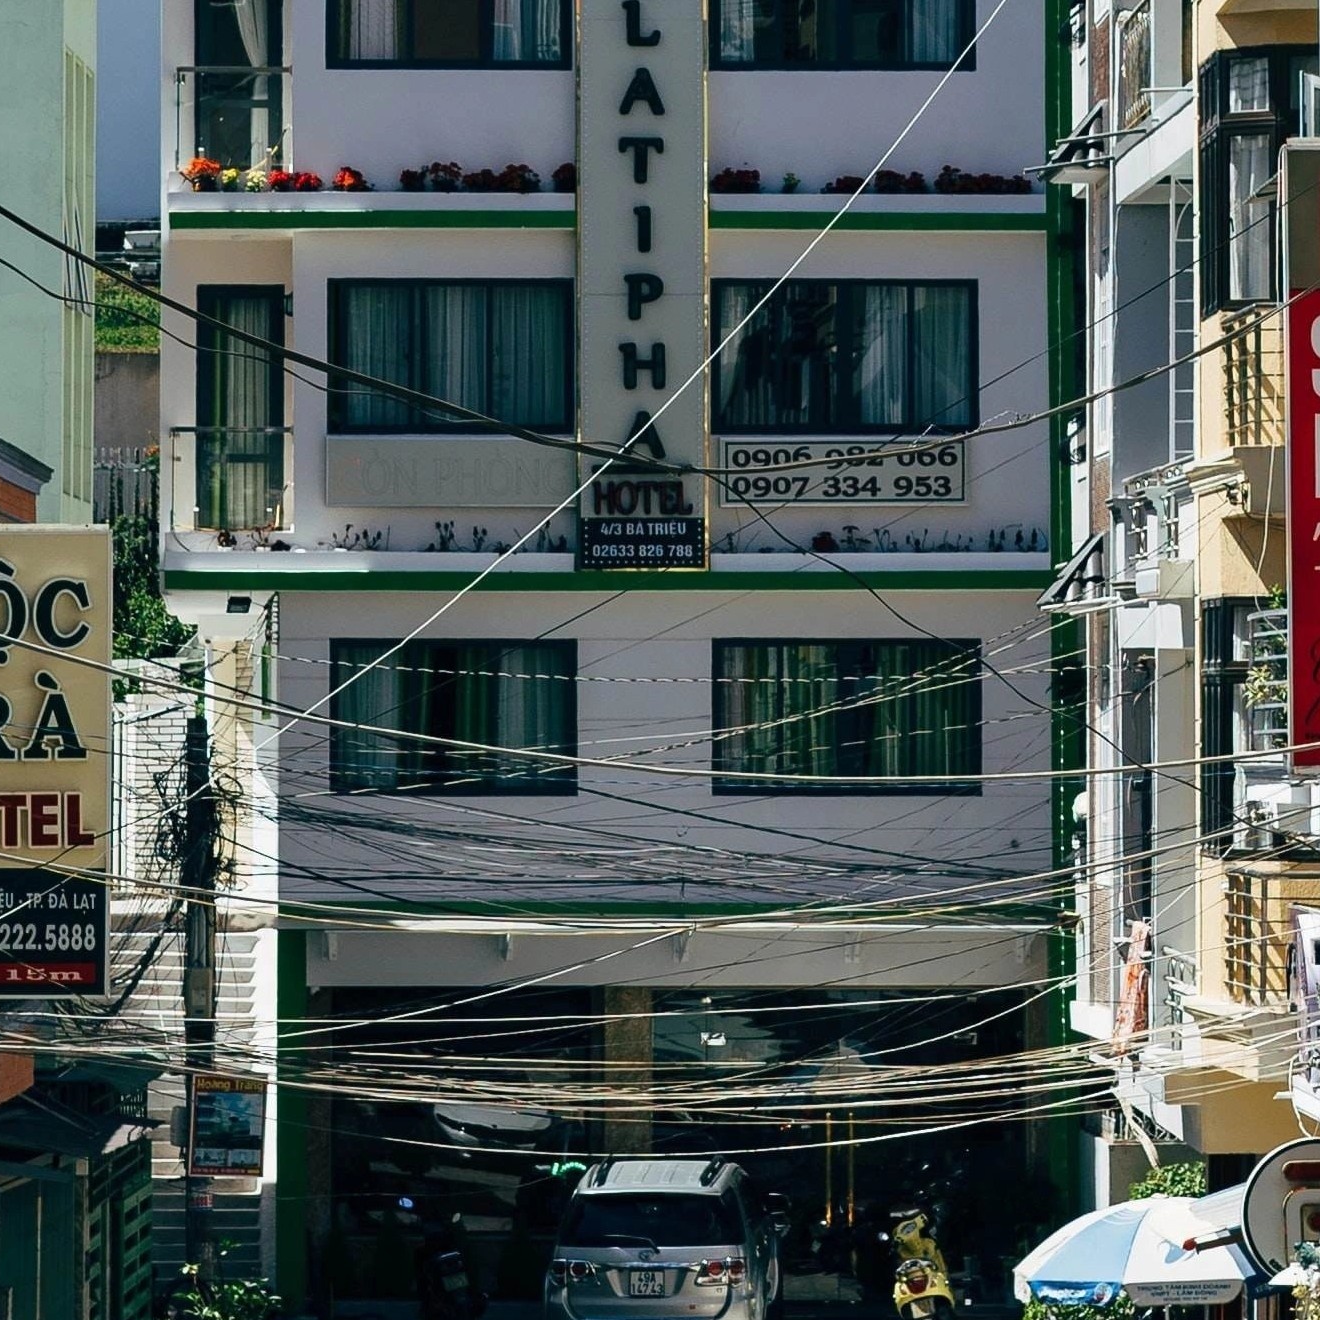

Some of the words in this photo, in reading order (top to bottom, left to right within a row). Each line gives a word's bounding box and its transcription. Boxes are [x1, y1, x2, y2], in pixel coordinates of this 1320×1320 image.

[731, 446, 812, 468] 0906
[591, 480, 694, 516] HOTEL
[731, 476, 811, 498] 0907
[822, 476, 881, 497] 334
[893, 476, 952, 497] 953
[600, 522, 622, 536] 4/3
[48, 889, 68, 909] ĐÀ
[73, 893, 96, 915] LẠT
[6, 968, 83, 981] 15m
